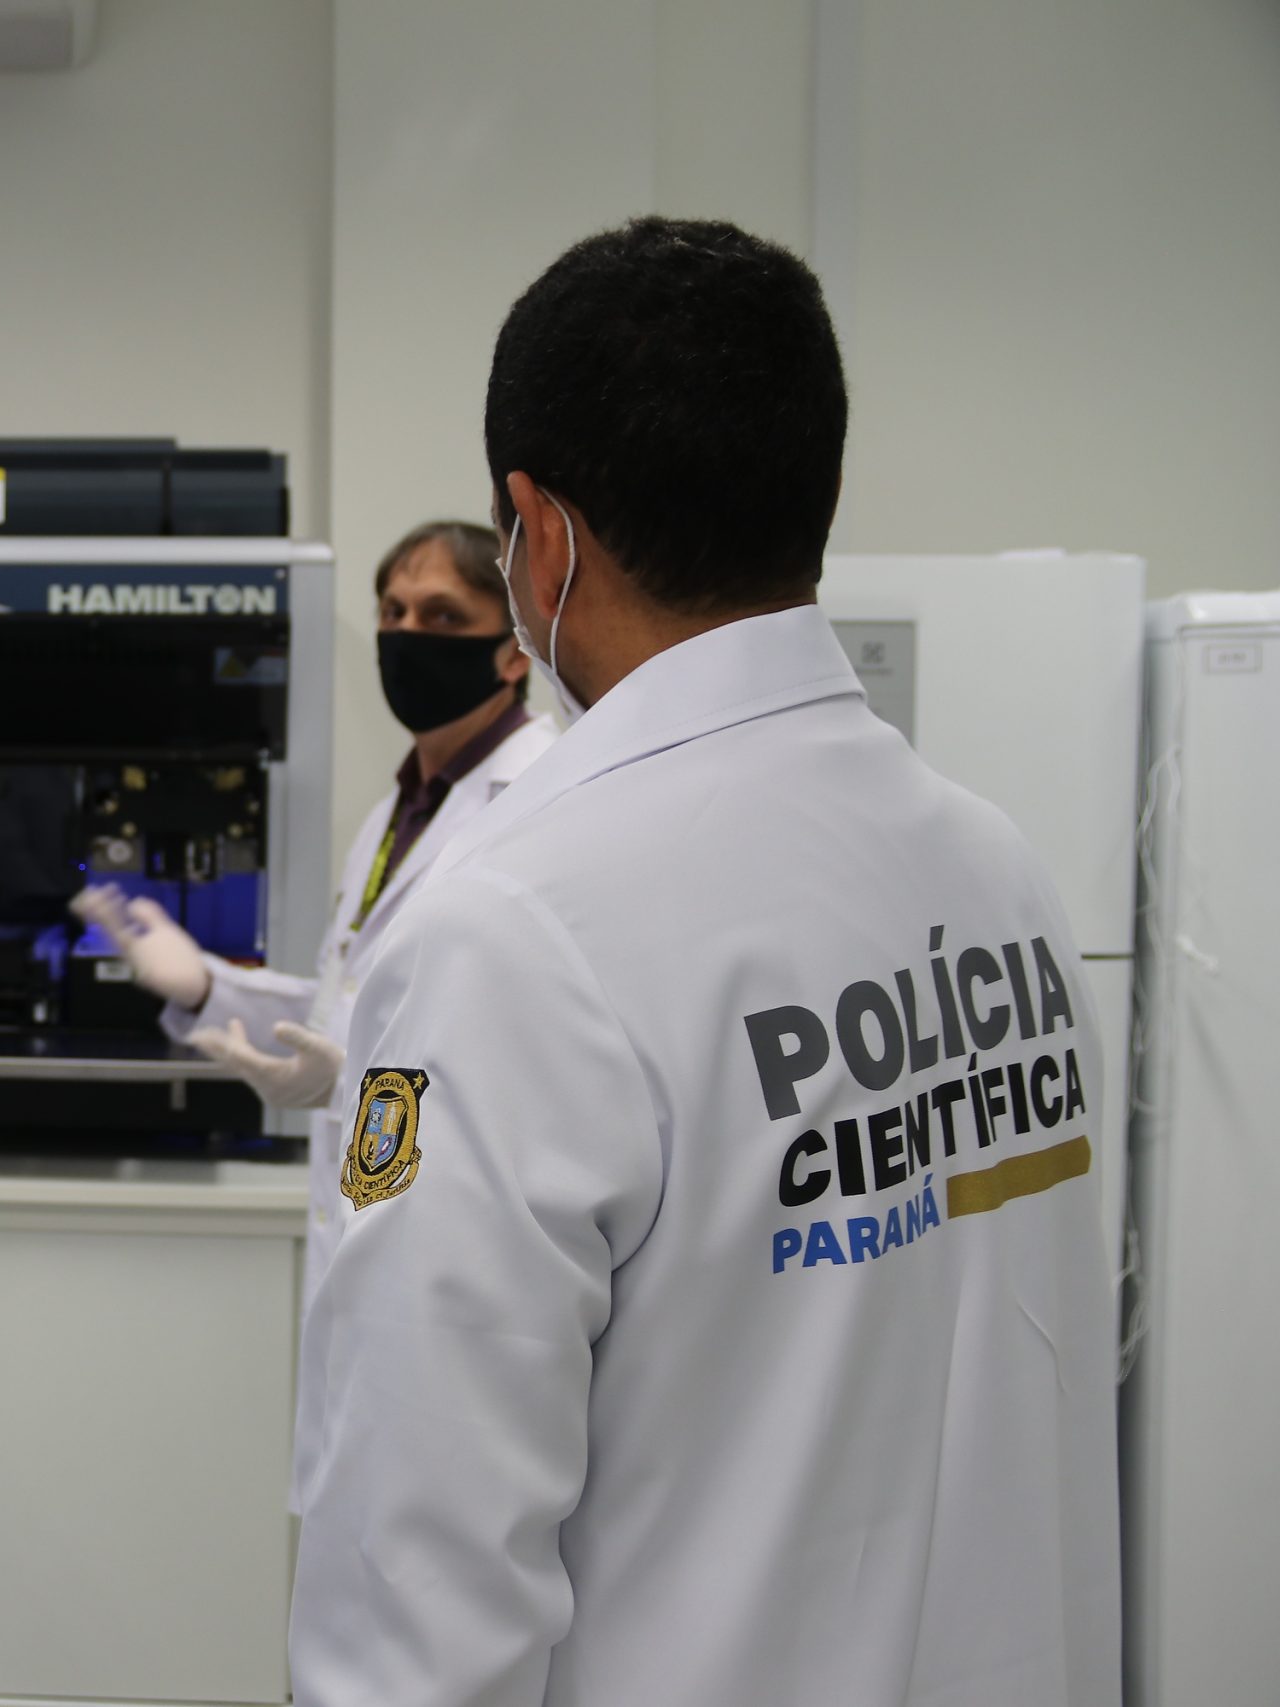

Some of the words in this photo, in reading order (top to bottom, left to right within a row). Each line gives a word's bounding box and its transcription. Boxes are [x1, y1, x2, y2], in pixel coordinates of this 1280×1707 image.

[48, 584, 277, 614] HAMILTON
[743, 925, 1074, 1121] POLÍCIA
[778, 1048, 1086, 1208] CIENTÍFICA
[772, 1174, 941, 1274] PARANÁ
